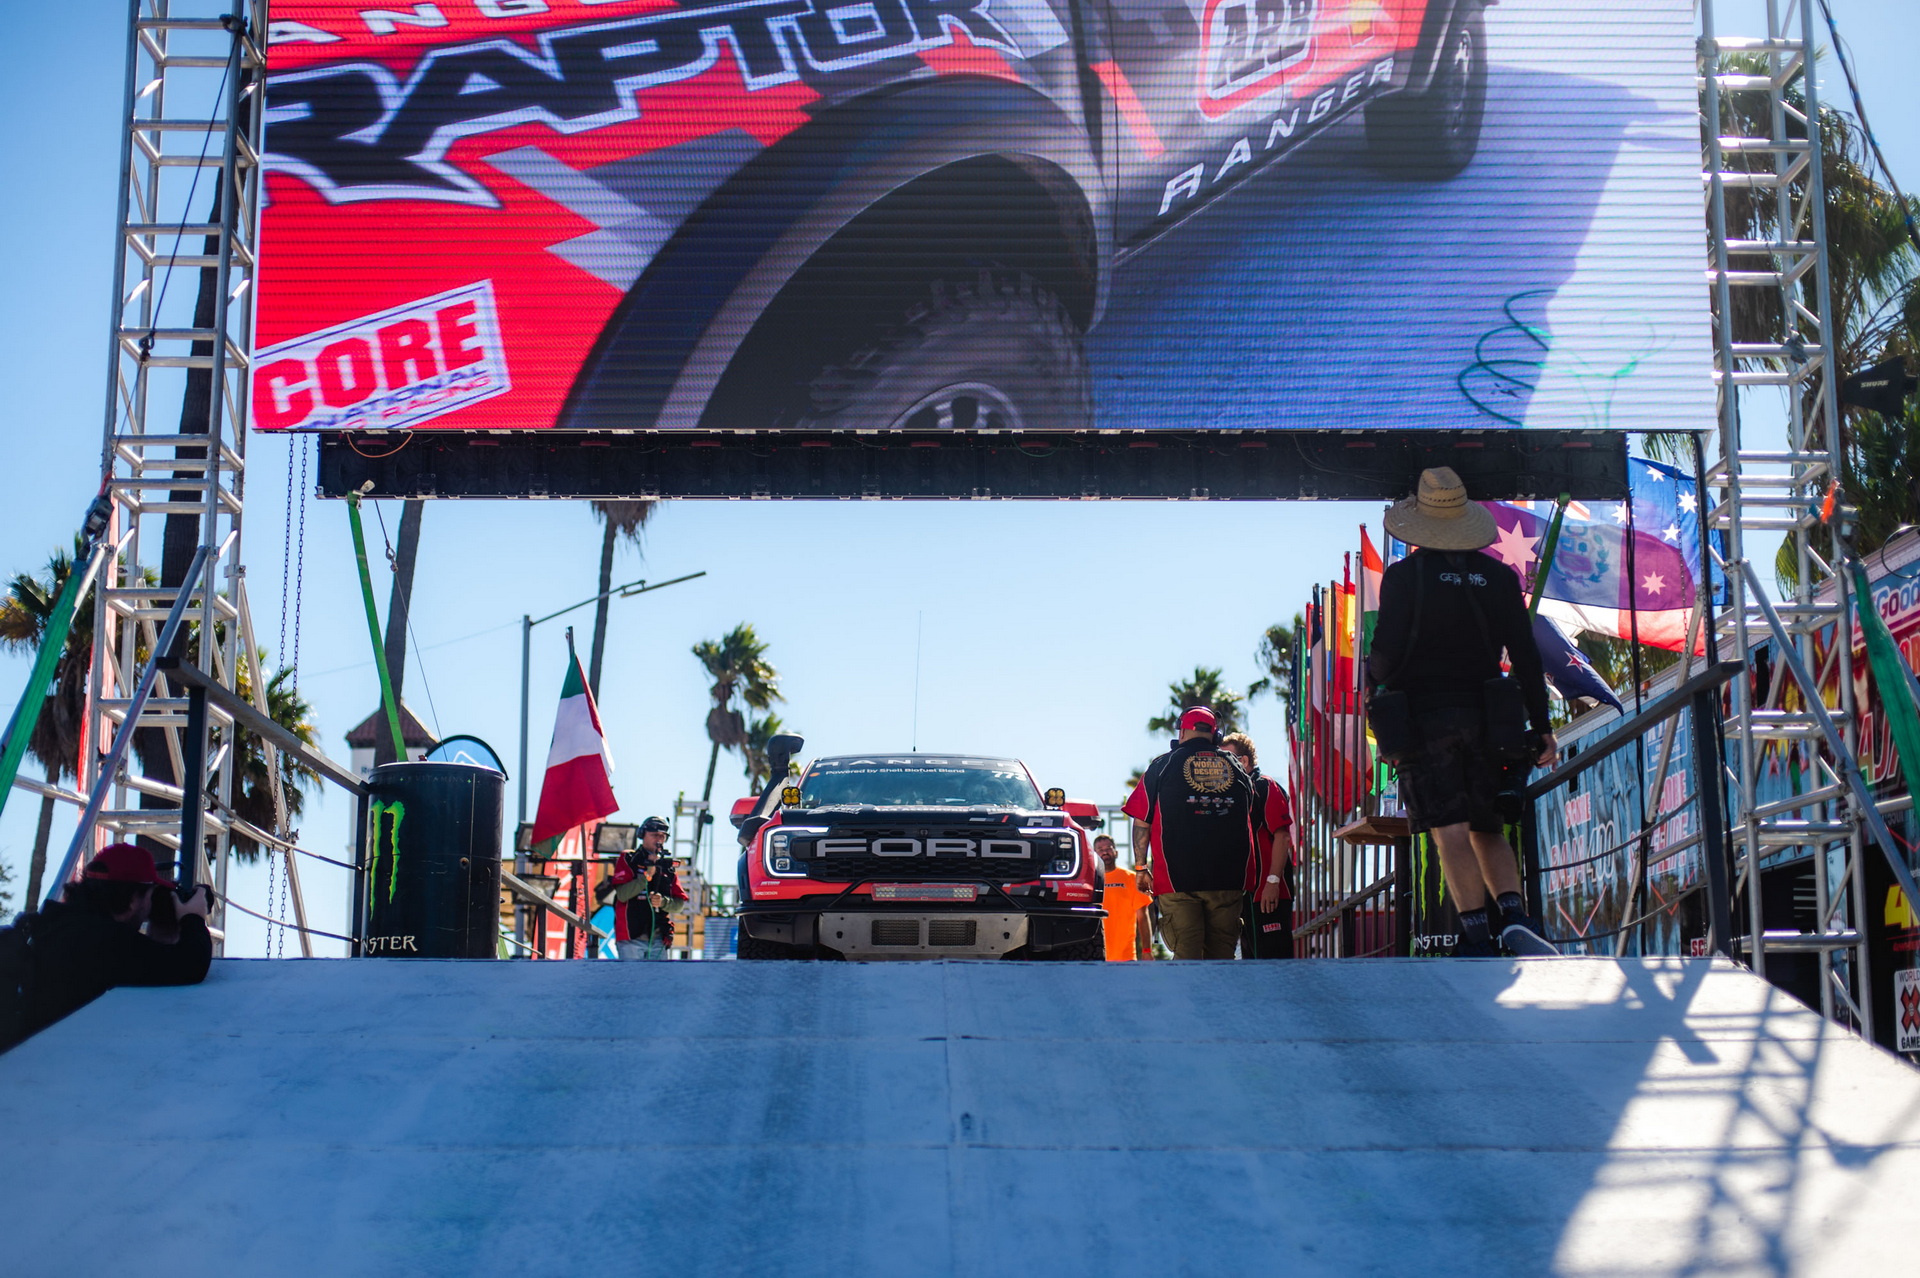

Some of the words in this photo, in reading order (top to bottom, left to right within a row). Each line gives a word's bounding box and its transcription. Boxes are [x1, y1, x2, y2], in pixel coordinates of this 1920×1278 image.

[1157, 57, 1394, 217] RANGER
[1860, 379, 1890, 389] SHURE
[1193, 760, 1224, 769] WORLD
[825, 768, 866, 776] Powered
[991, 770, 1027, 781] 773
[816, 838, 1032, 859] FORD
[1548, 834, 1586, 895] BAJA
[1586, 820, 1616, 883] 400
